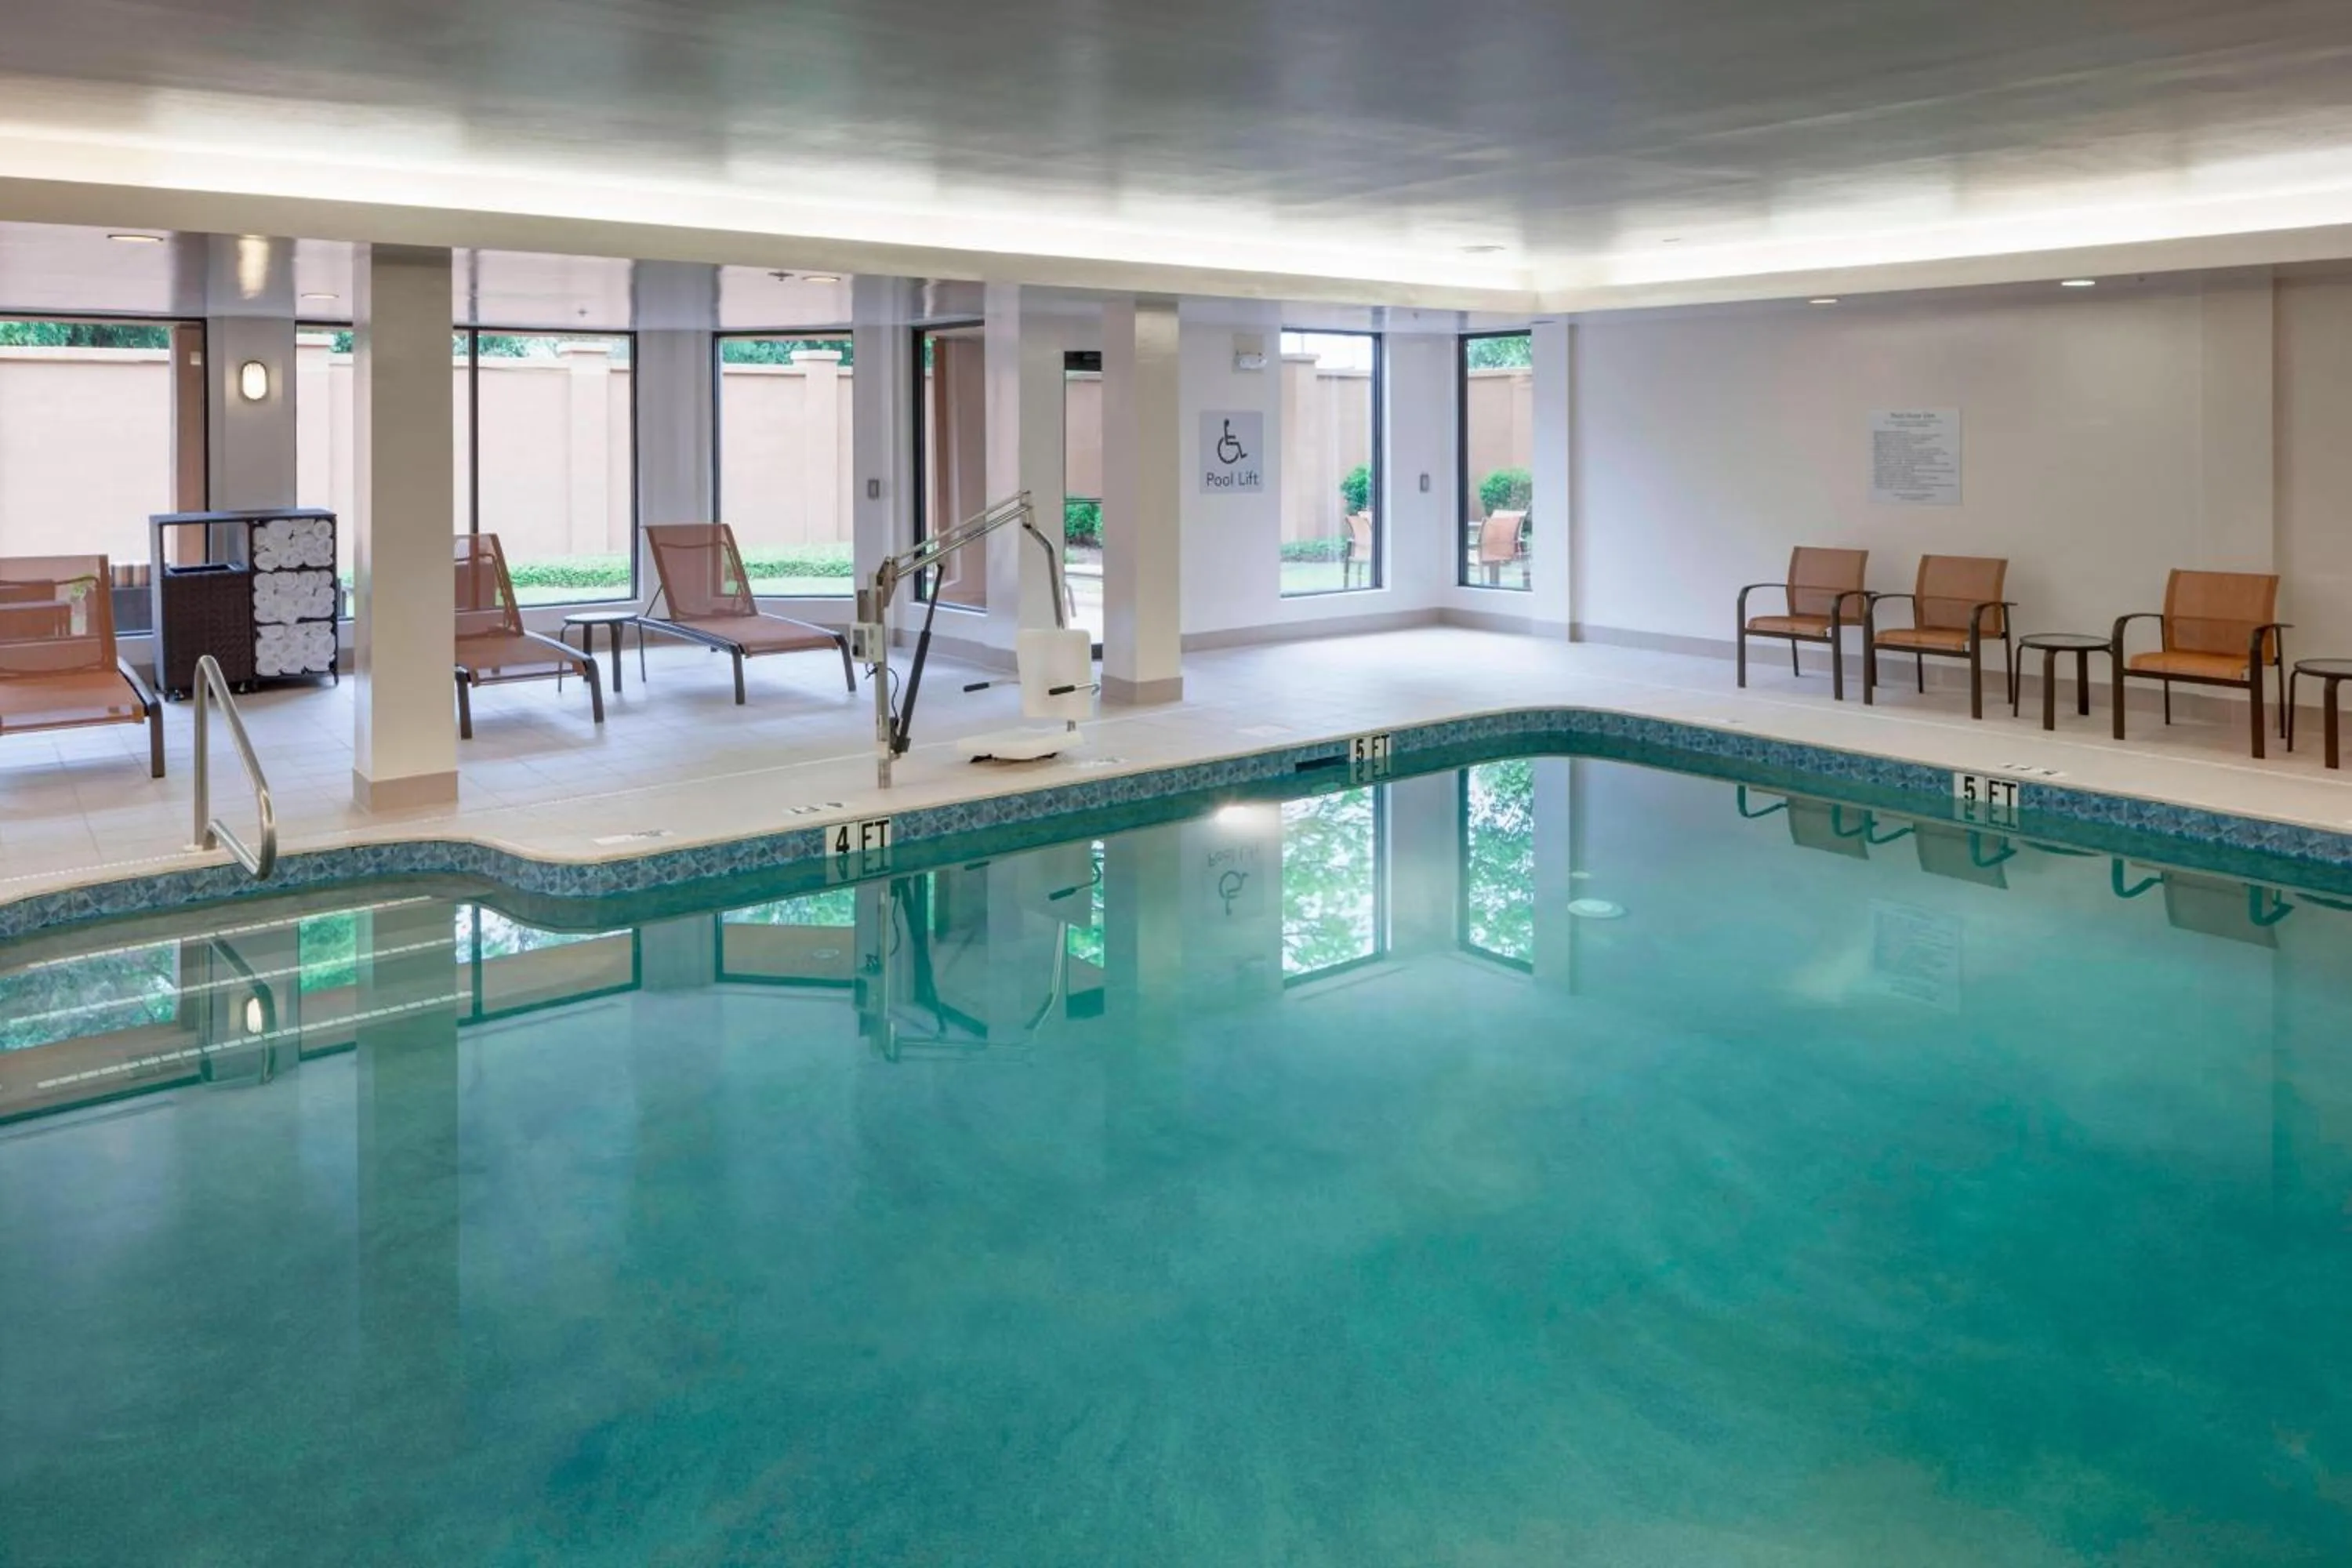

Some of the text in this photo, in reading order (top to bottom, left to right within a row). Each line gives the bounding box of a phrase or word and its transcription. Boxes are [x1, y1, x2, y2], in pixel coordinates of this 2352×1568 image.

[1207, 470, 1259, 486] Pool Lift
[1356, 734, 1389, 760] 5 FT
[1964, 776, 2016, 806] 5 FT
[835, 820, 889, 854] 4 FT
